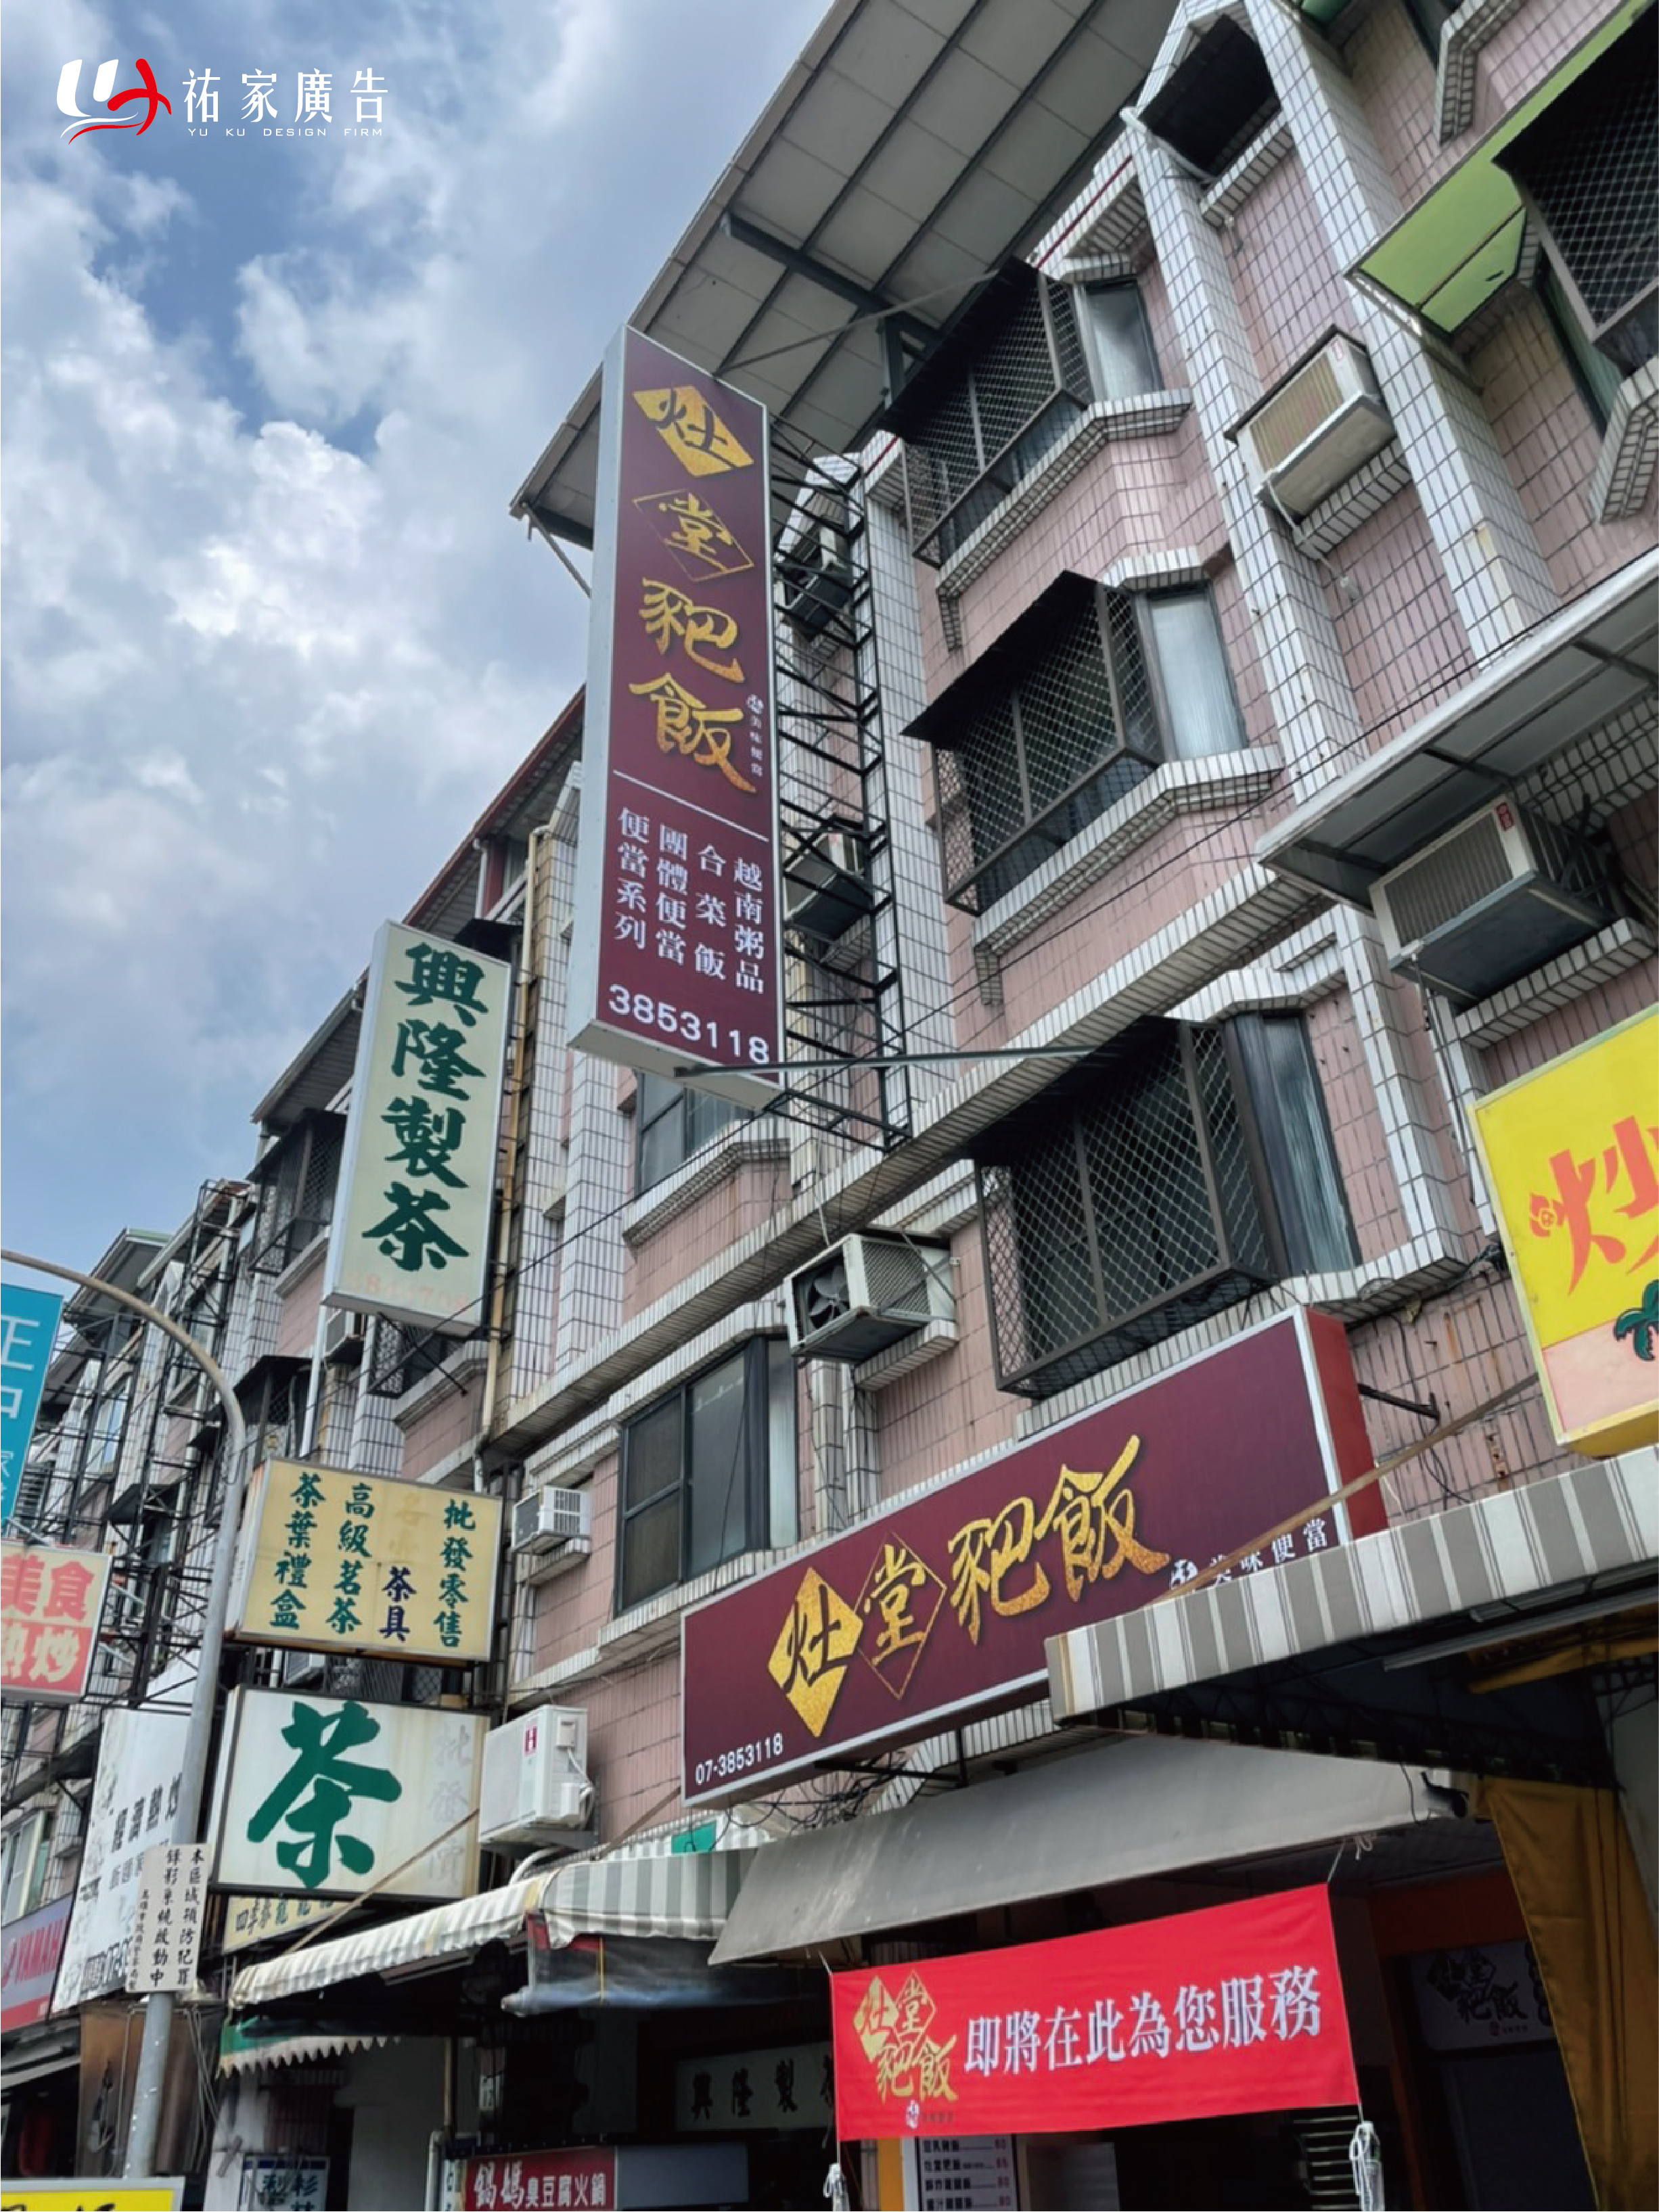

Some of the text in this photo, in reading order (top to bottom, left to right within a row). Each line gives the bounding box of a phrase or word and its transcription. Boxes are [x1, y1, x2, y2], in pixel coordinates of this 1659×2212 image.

[614, 807, 650, 949] 便當系列
[655, 824, 689, 966] 團體便當
[733, 857, 765, 994] 越南粥品
[608, 984, 769, 1064] 3853118
[361, 942, 488, 1272] 興隆製茶
[269, 1471, 326, 1630] 茶葉禮盒
[326, 1482, 375, 1634] 高級茗茶
[379, 1566, 417, 1642] 茶具
[433, 1498, 476, 1648] 批發零售
[247, 1700, 403, 1889] 茶
[695, 1732, 783, 1786] 07-3853118
[963, 1965, 1321, 2077] 即將在此為您服務
